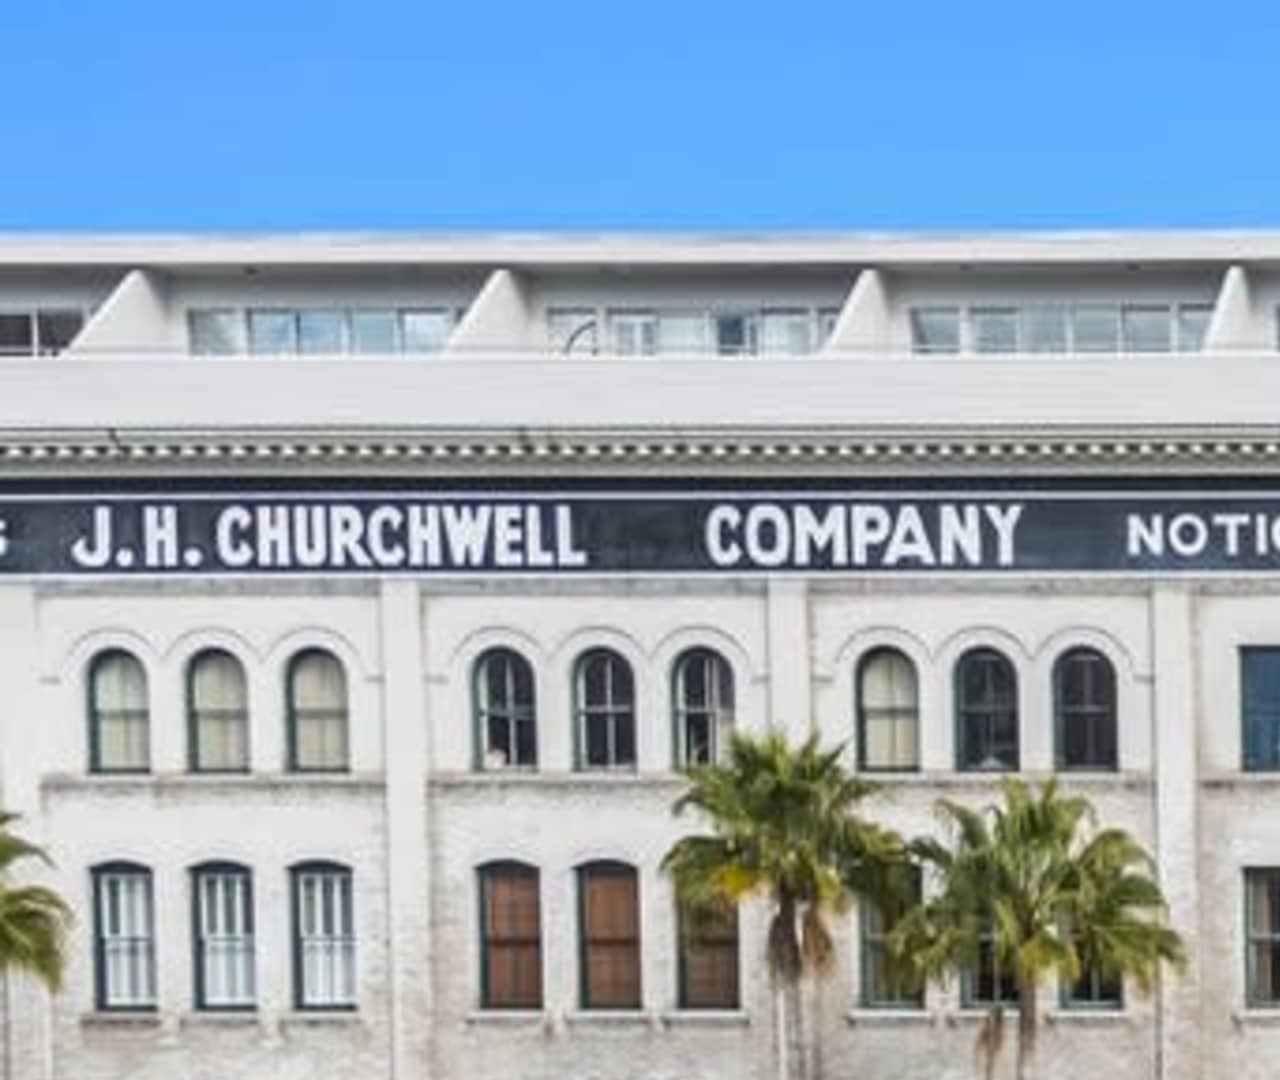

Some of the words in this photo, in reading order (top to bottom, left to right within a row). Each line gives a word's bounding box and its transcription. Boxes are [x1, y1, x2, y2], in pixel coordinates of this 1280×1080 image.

[71, 506, 203, 567] J.H.
[217, 506, 587, 567] CHURCHWELL
[706, 504, 1022, 566] COMPANY
